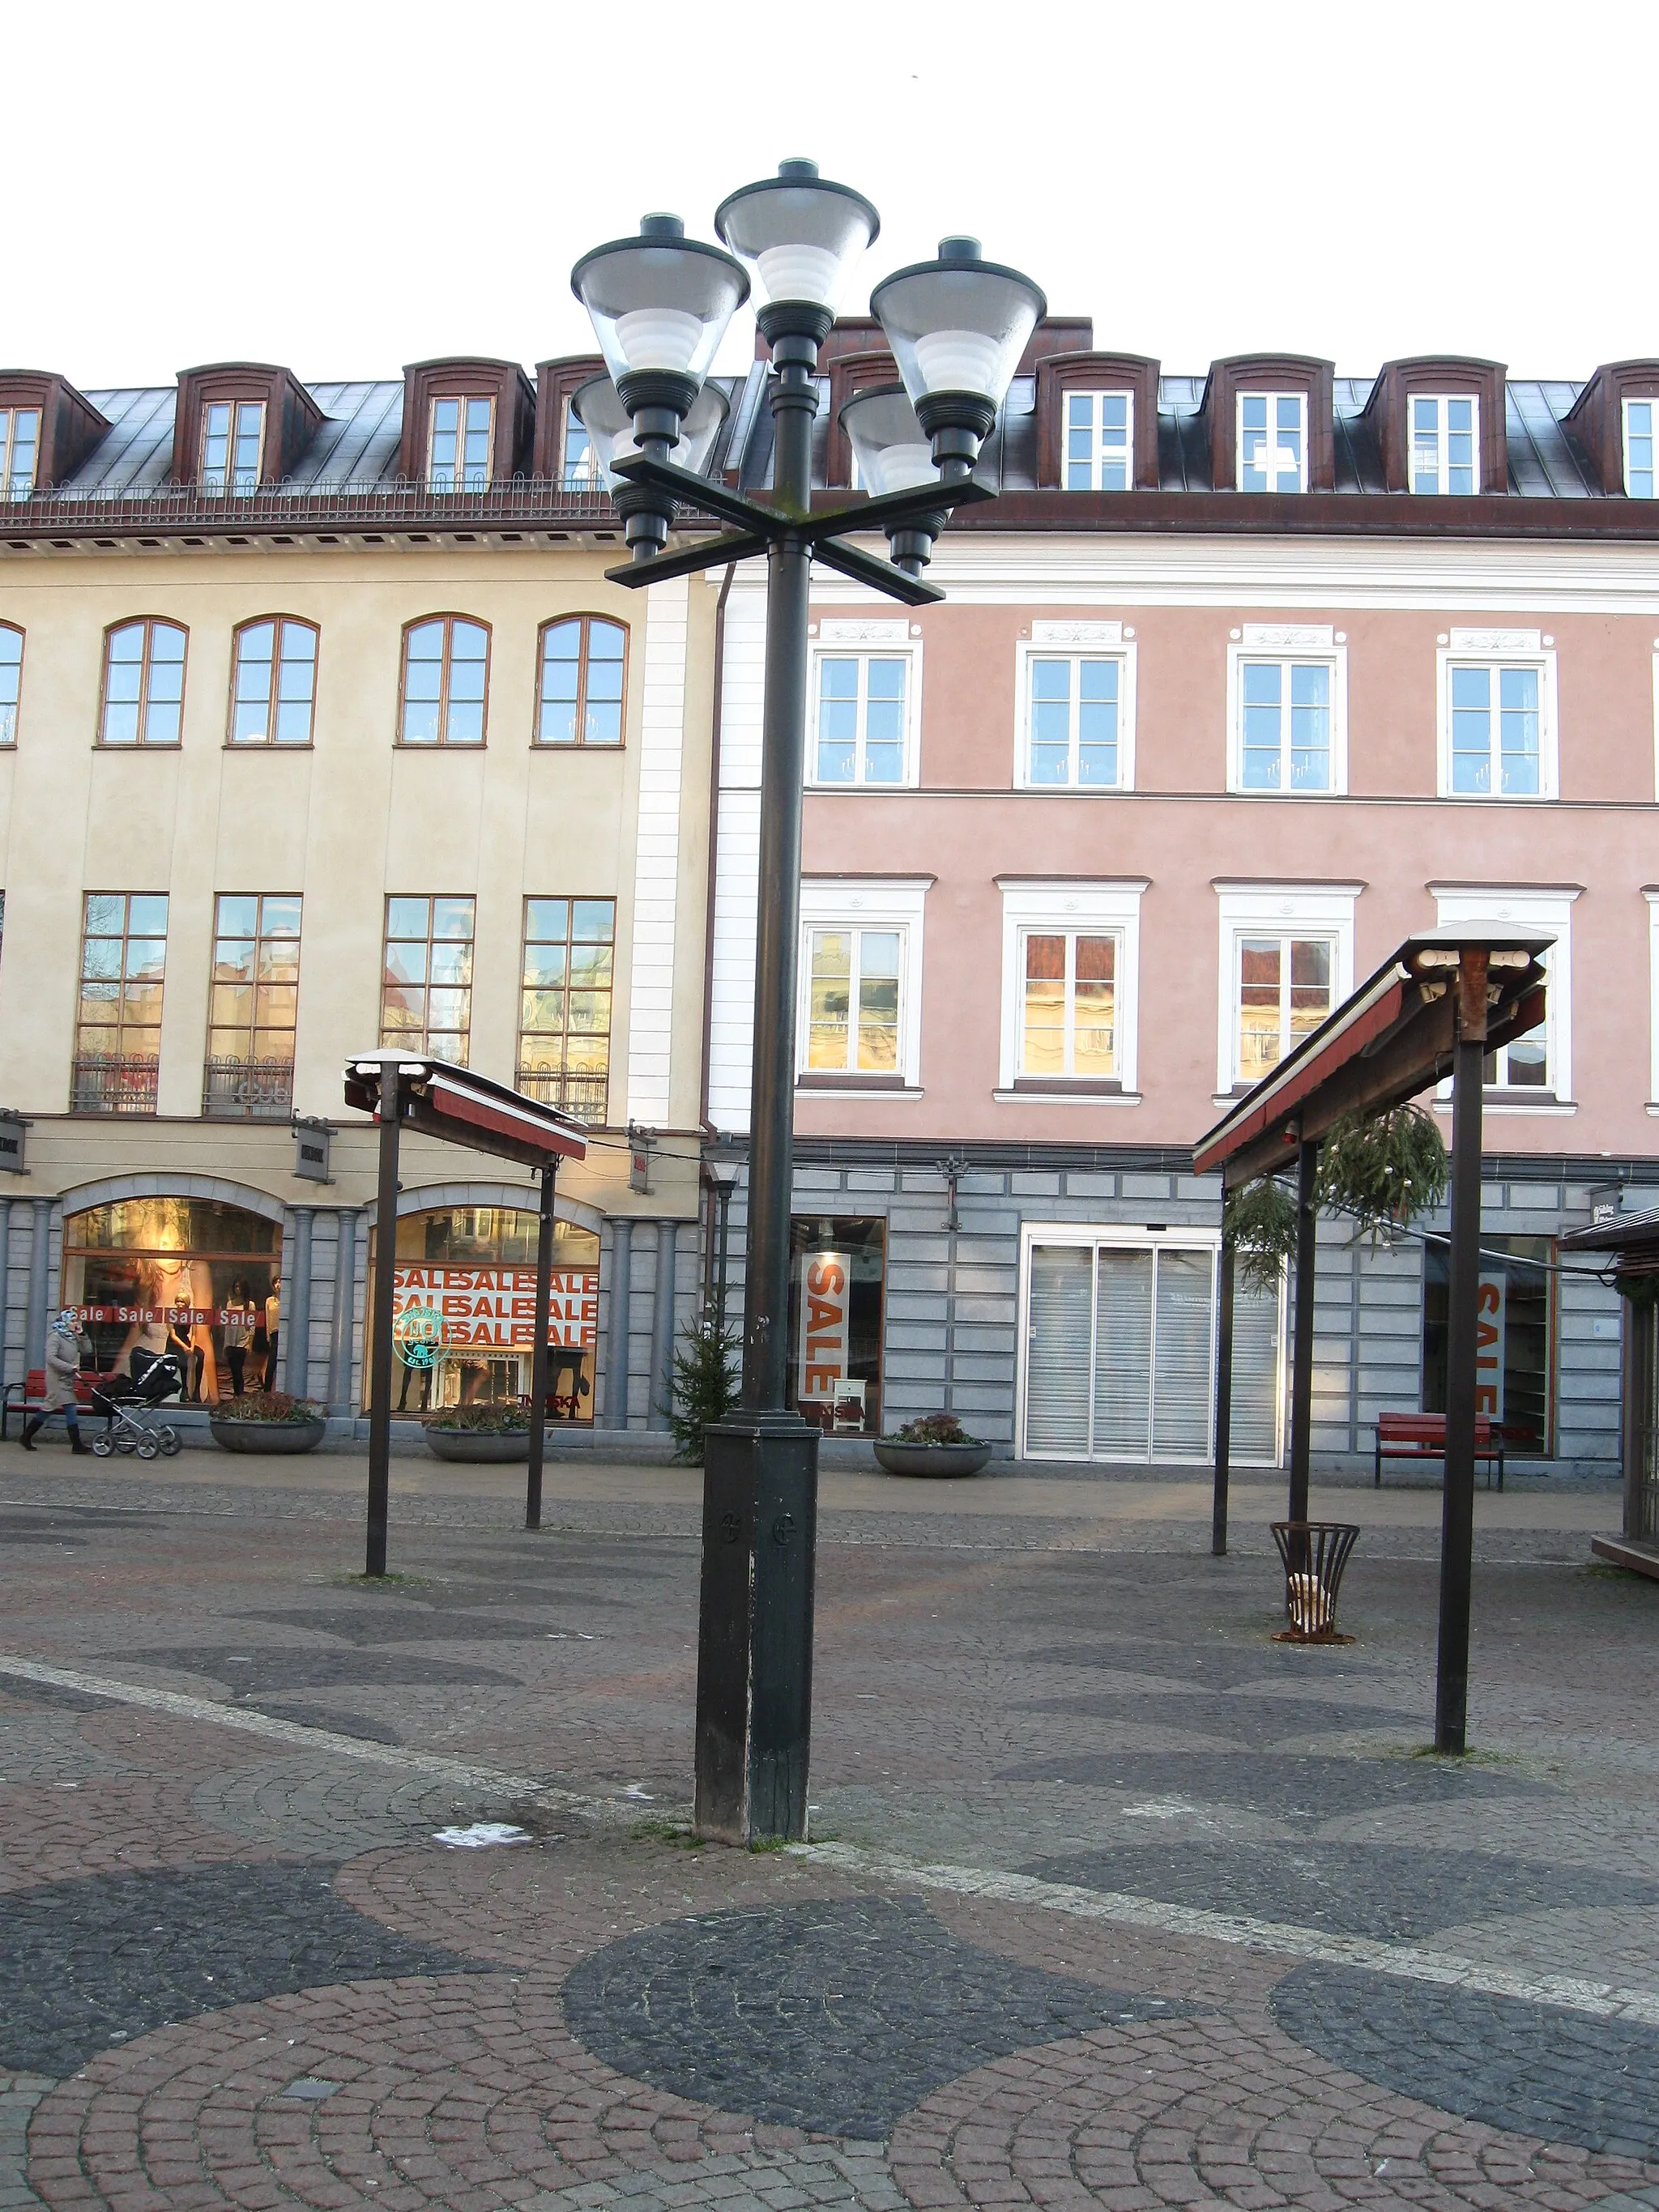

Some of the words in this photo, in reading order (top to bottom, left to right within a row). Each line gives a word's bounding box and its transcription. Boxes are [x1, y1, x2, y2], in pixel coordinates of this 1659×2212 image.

[394, 1269, 458, 1289] SALE
[458, 1270, 529, 1291] SALE
[118, 1306, 154, 1323] Sale
[168, 1308, 204, 1324] Sale
[220, 1310, 255, 1326] Sale
[457, 1295, 527, 1319] SALE
[456, 1321, 527, 1345] SALE
[805, 1260, 844, 1394] SALE
